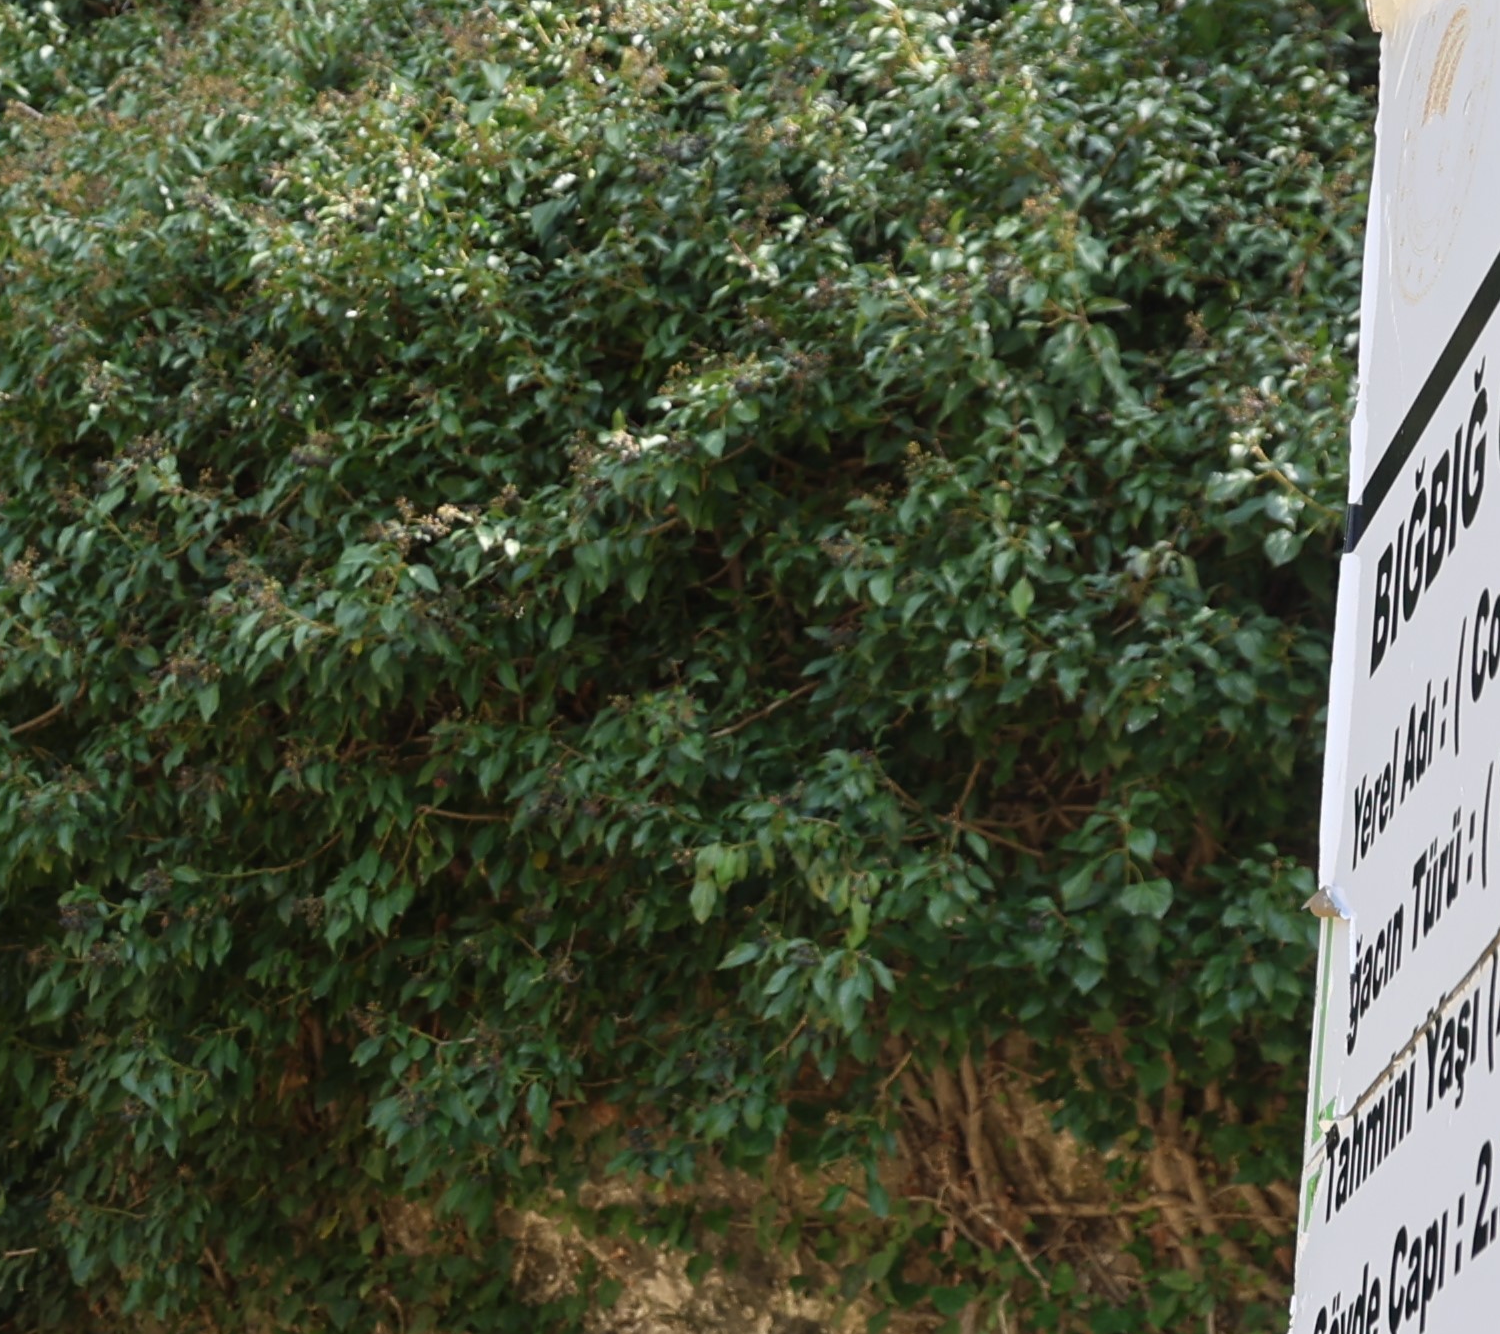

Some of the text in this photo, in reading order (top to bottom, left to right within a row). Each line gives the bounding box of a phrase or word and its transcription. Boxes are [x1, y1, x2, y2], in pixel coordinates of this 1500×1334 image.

[1371, 356, 1488, 679] BIĞBIĞ
[1352, 726, 1400, 872] Yerel
[1400, 679, 1436, 806] Adı
[1412, 805, 1462, 953] Türü
[1325, 1023, 1417, 1224] Tahmini
[1424, 989, 1481, 1114] Yaşı
